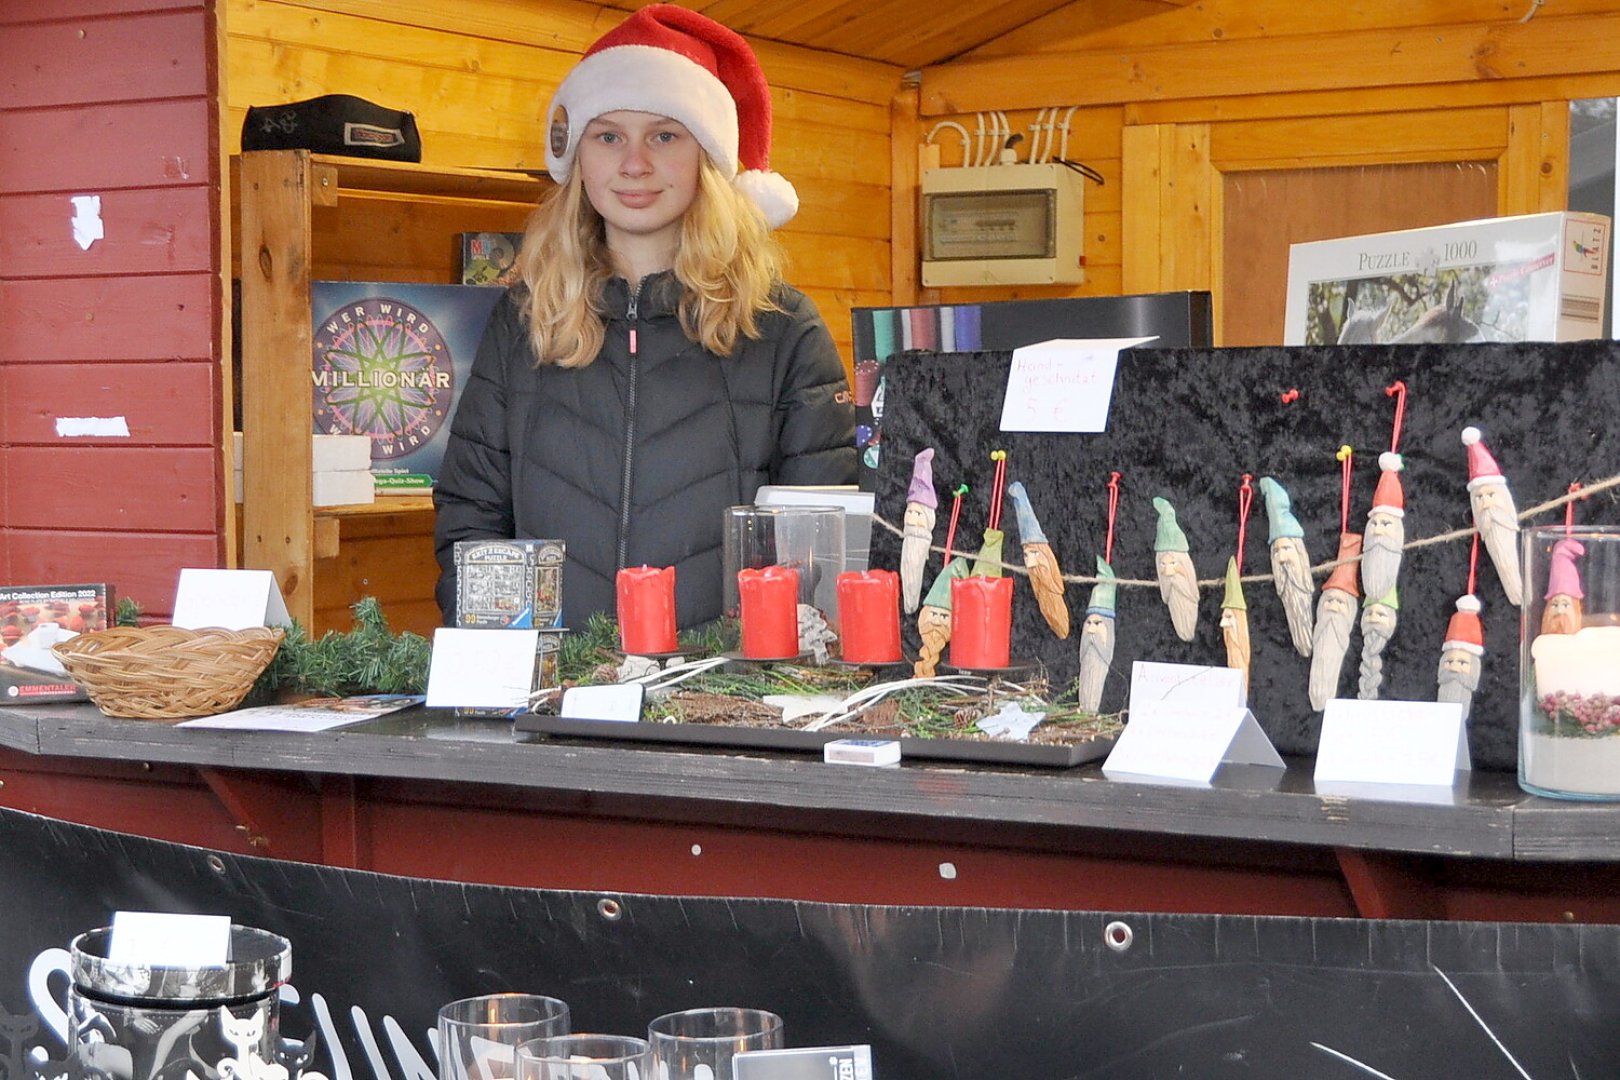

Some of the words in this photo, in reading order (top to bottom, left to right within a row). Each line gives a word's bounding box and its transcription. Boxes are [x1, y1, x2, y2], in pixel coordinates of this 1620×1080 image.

[1444, 239, 1478, 261] 1000
[326, 306, 365, 334] WER
[380, 303, 430, 334] WIRD
[312, 366, 450, 389] MILLIONÄR
[382, 425, 431, 456] WIRD
[12, 591, 50, 600] Collection
[51, 590, 77, 599] Edition
[78, 589, 96, 598] 2022
